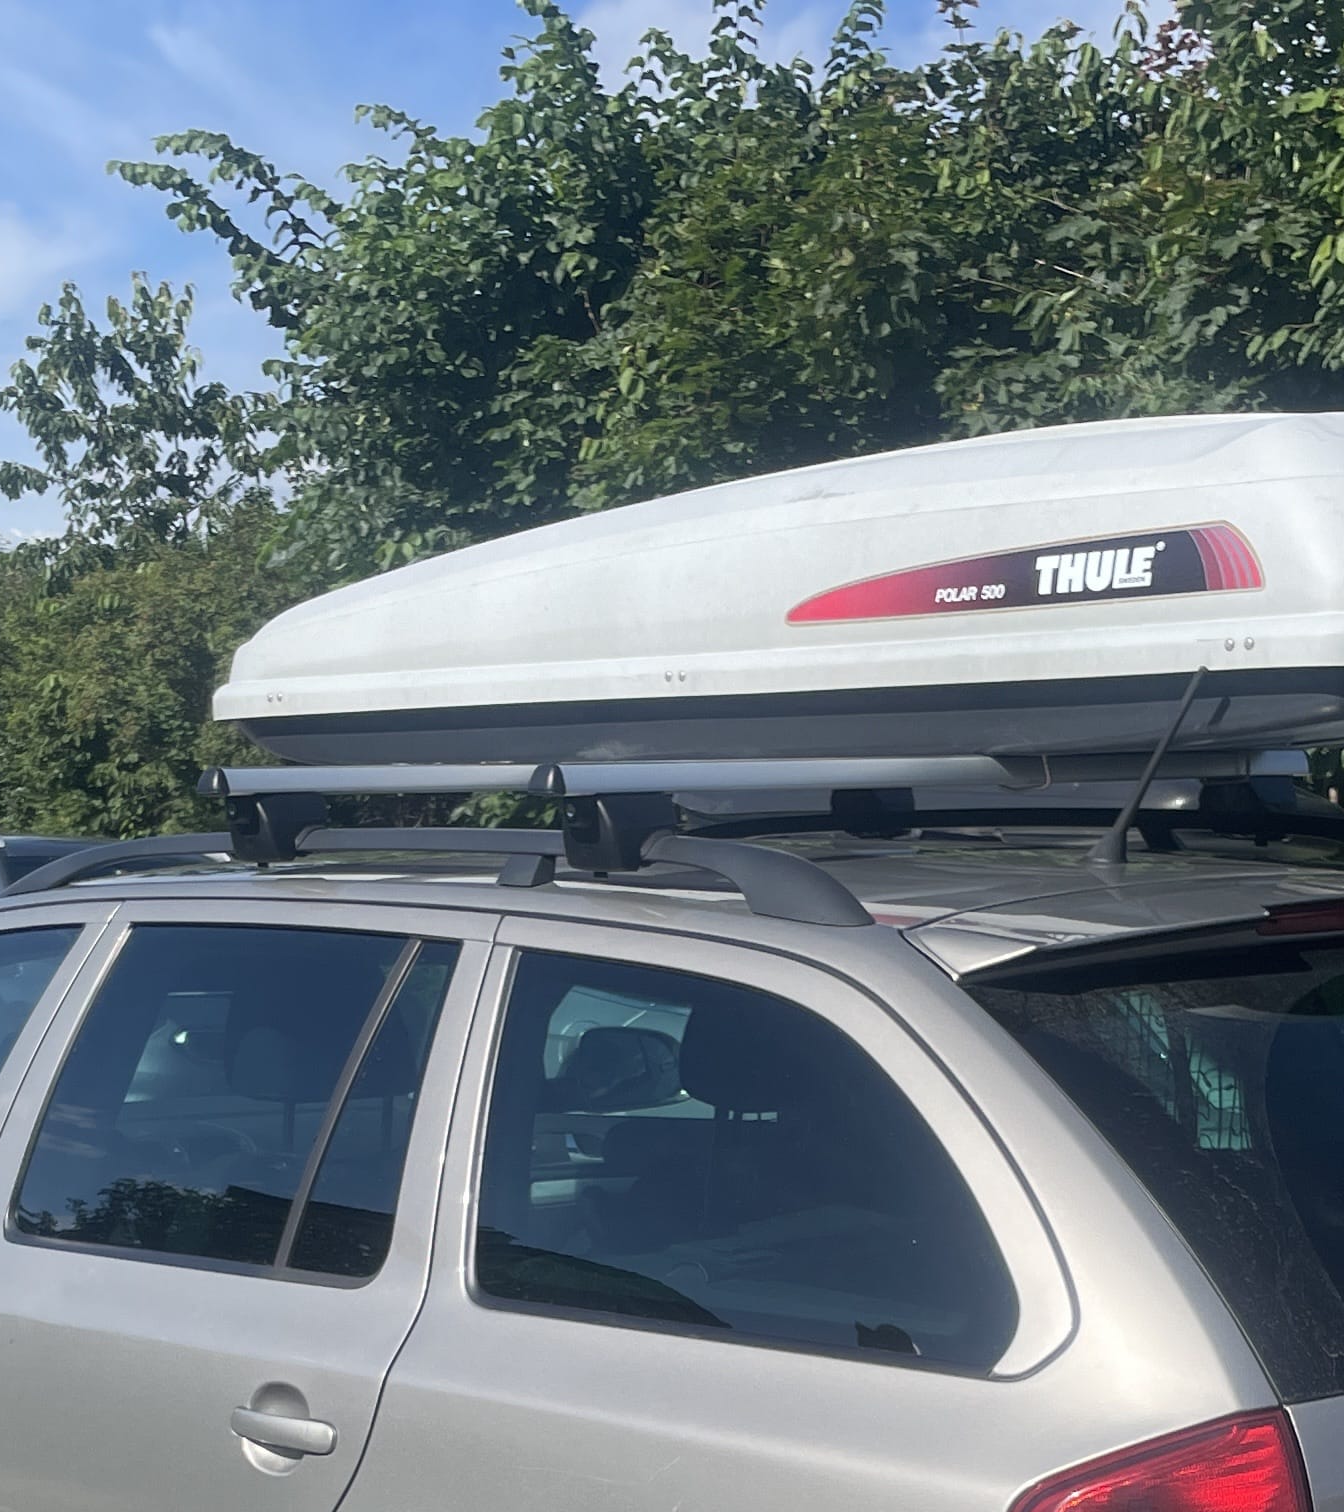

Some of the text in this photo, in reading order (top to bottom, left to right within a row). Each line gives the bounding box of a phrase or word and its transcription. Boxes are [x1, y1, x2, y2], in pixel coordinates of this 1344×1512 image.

[1035, 546, 1156, 596] THULE
[935, 583, 1006, 603] POLAR 500
